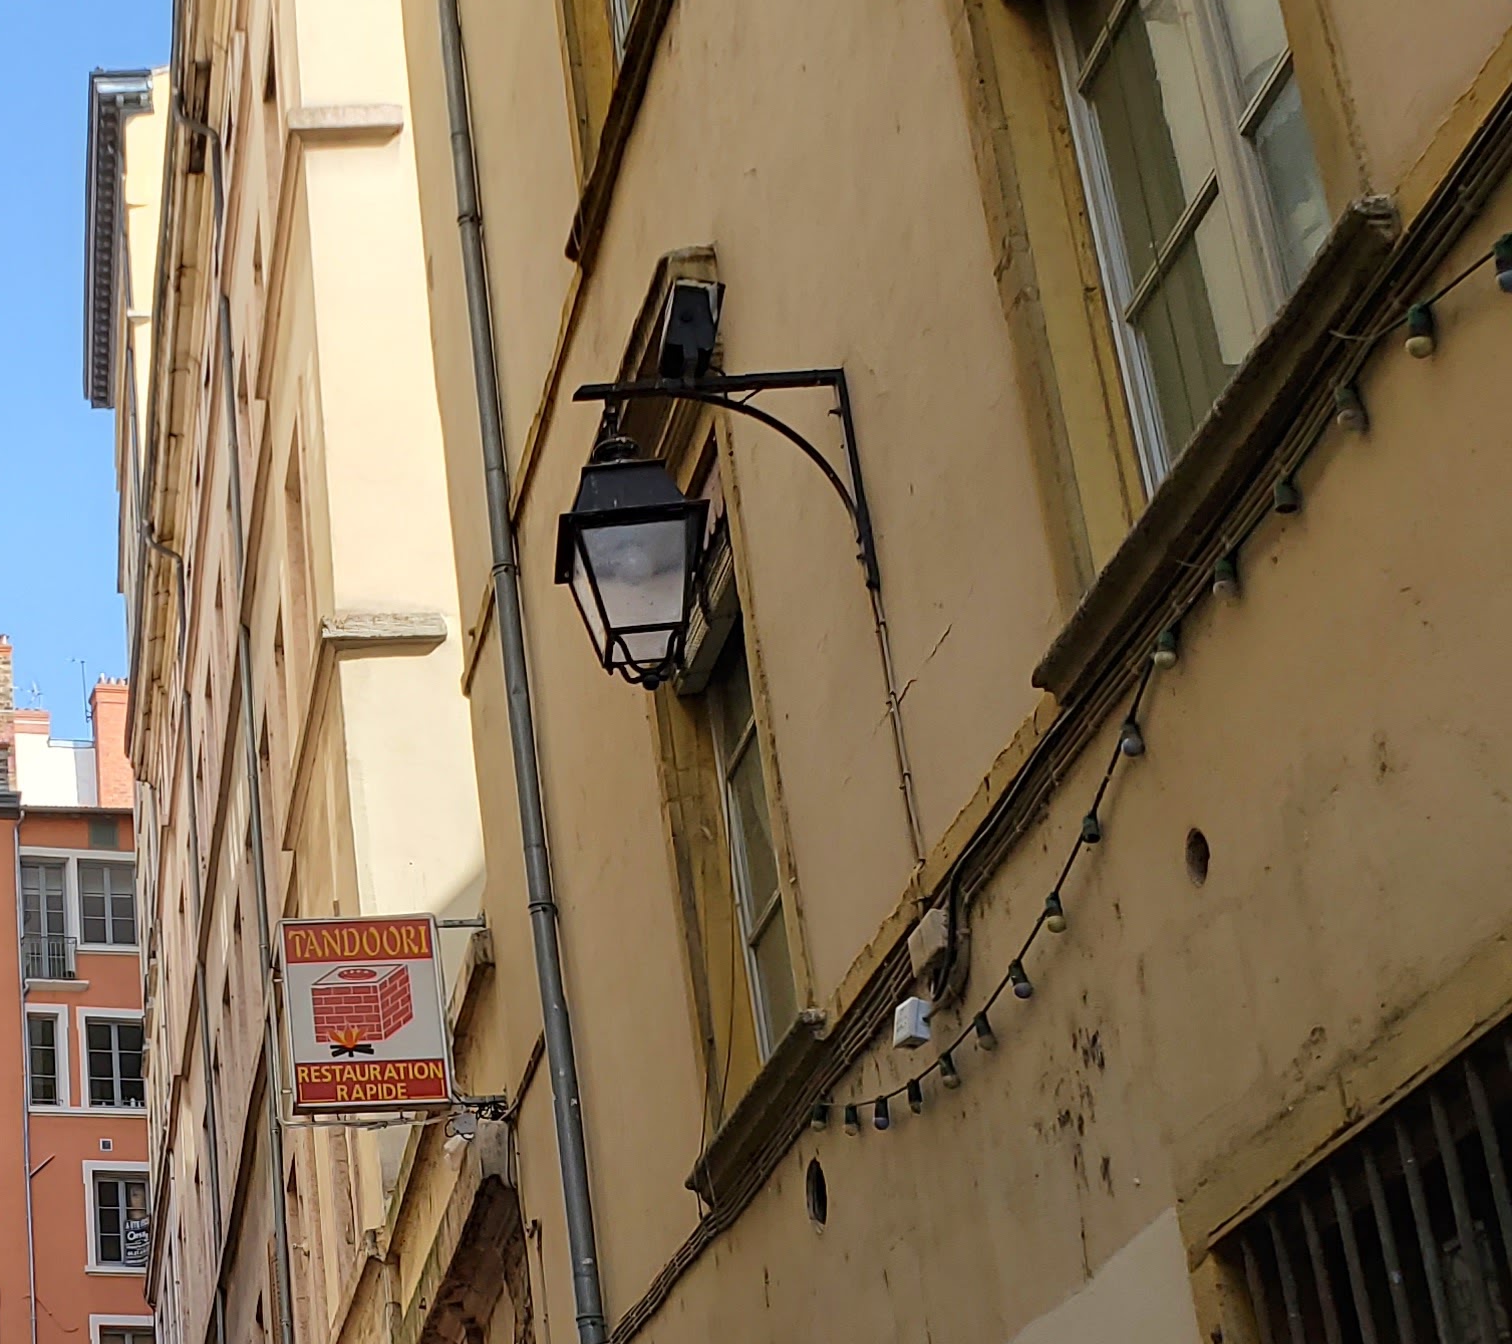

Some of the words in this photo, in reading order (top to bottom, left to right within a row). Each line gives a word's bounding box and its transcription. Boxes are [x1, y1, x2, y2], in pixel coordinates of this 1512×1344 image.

[289, 926, 428, 958] TANDOORI
[298, 1062, 443, 1083] RESTAURATION
[337, 1083, 407, 1100] RAPIDE
